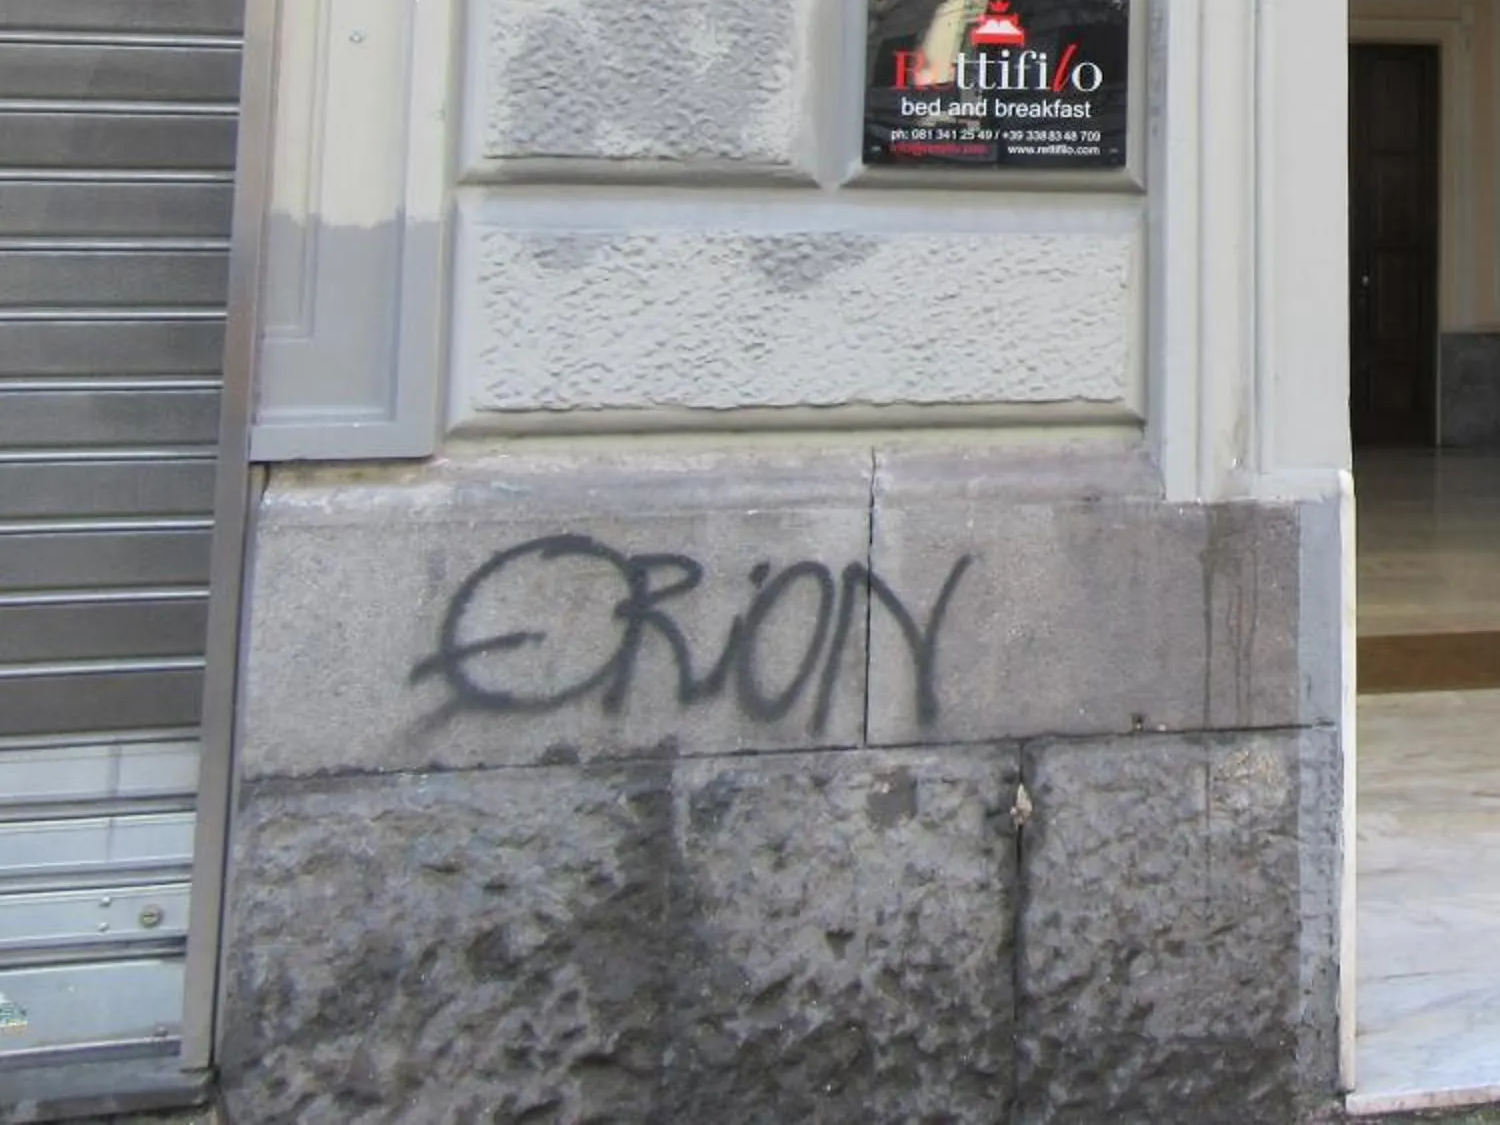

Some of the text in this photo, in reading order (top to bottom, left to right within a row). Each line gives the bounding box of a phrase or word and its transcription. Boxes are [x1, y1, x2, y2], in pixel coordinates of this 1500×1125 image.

[901, 97, 1091, 118] bed and breakfast
[891, 129, 909, 142] ph:
